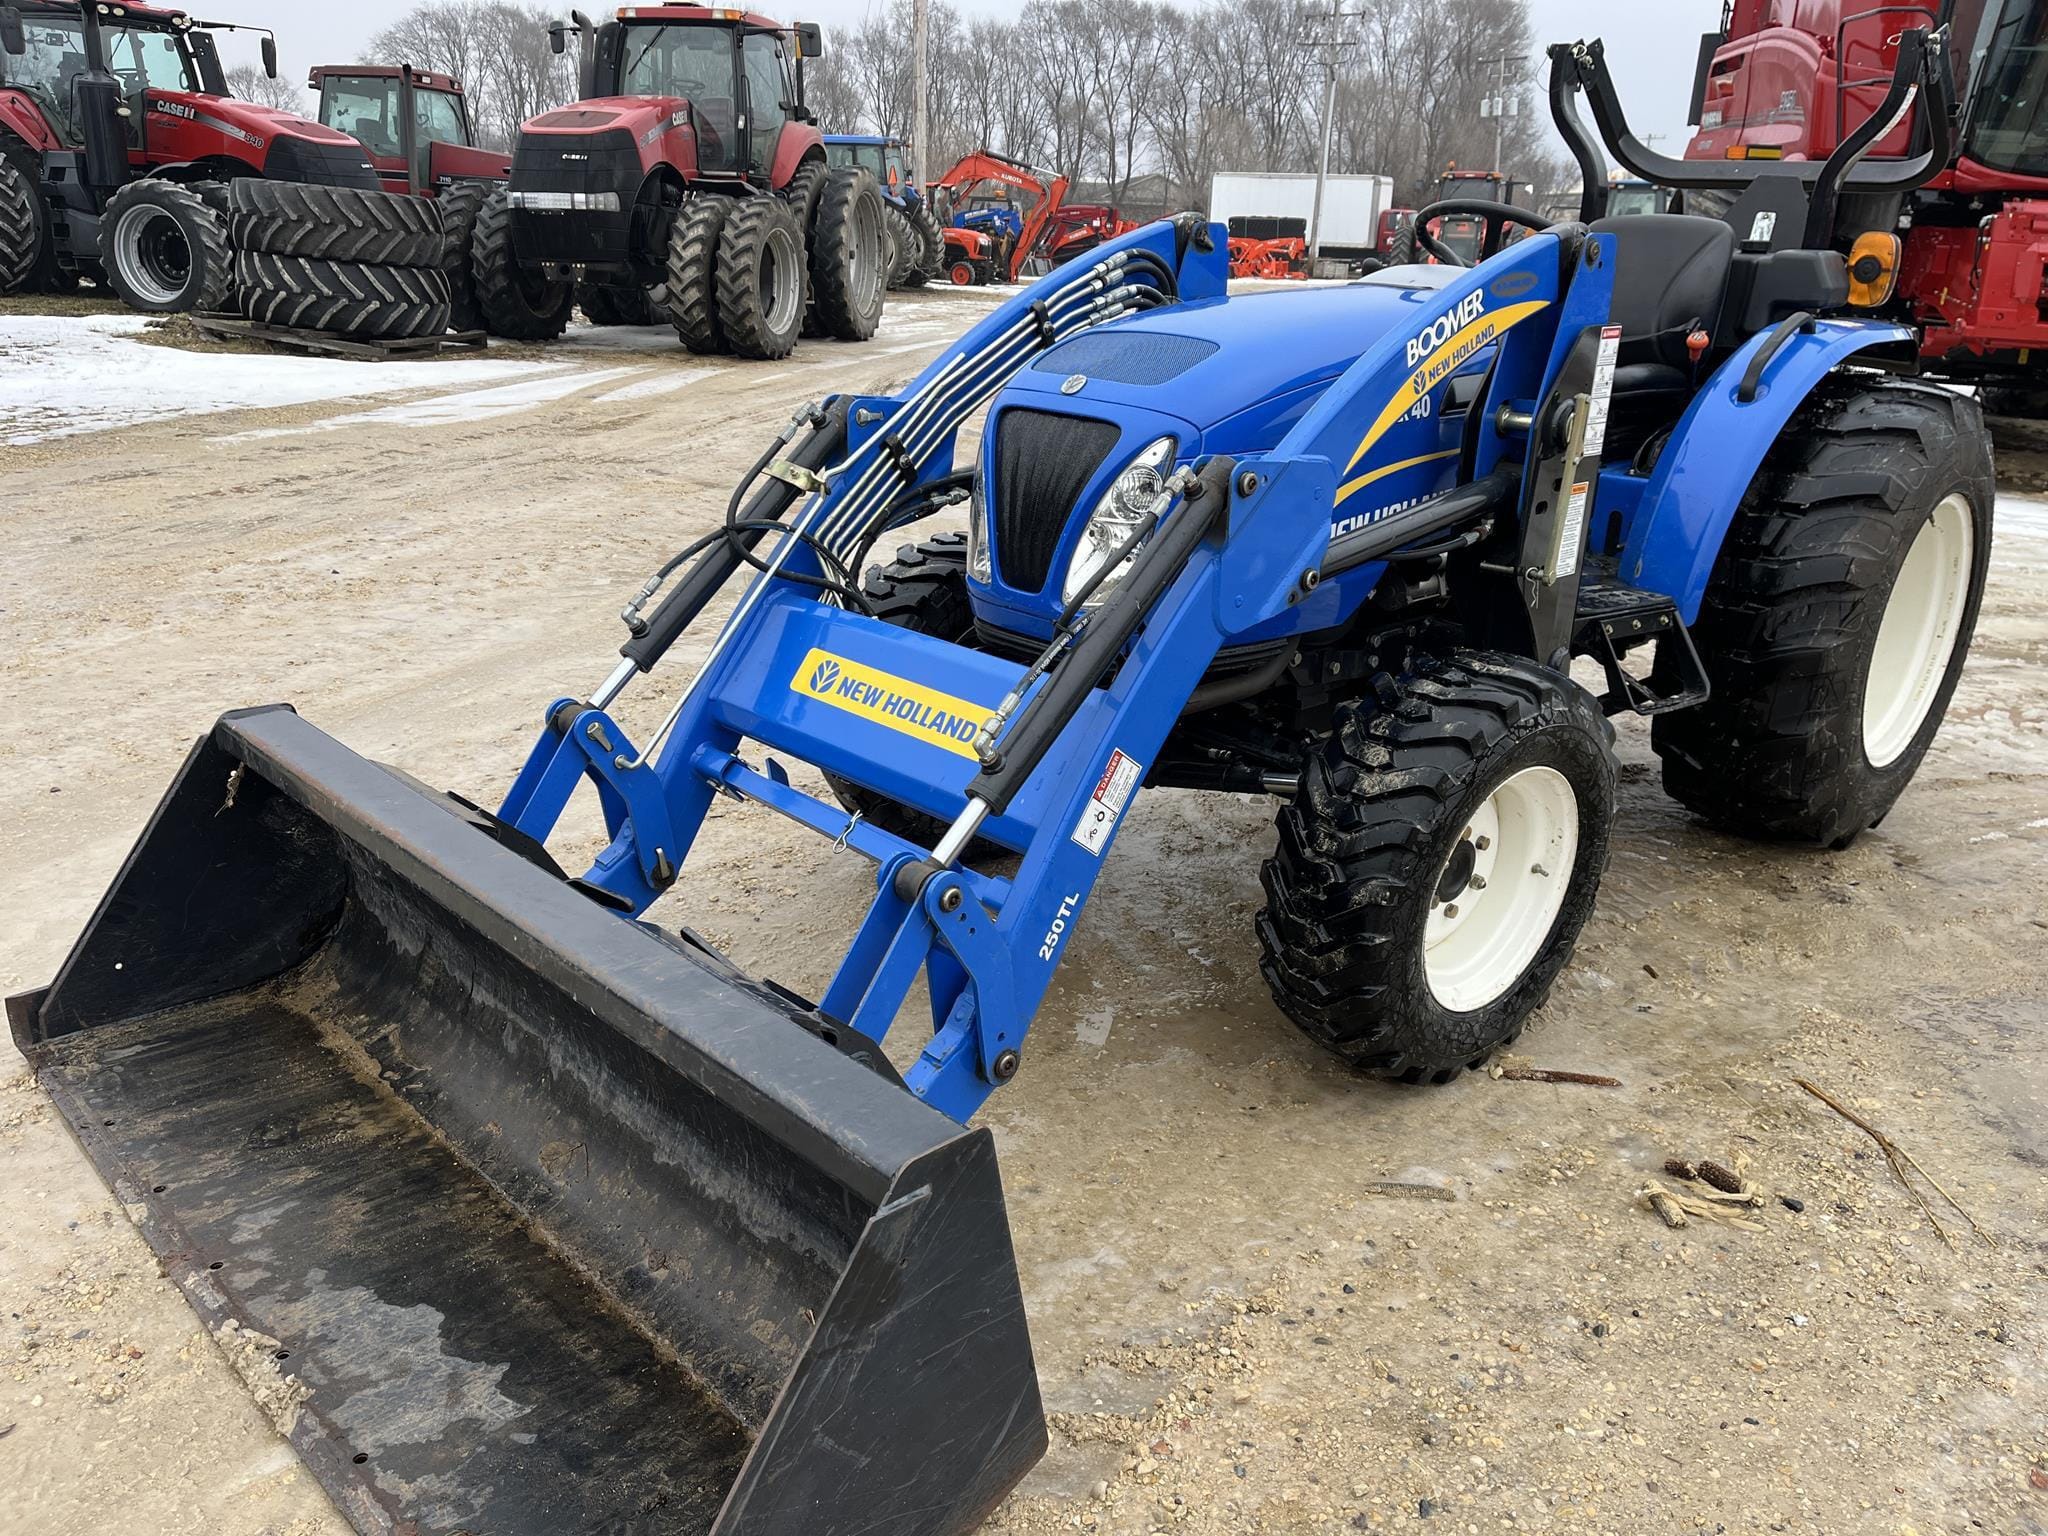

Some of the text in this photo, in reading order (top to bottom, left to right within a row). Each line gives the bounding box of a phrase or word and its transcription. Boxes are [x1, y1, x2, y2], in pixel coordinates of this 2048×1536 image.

[244, 133, 264, 149] 340
[1001, 173, 1023, 185] KUBOTA
[1407, 288, 1485, 368] BOOMER
[1428, 323, 1495, 383] NEW HOLLAND
[1411, 394, 1431, 420] 40
[836, 676, 977, 744] NEW HOLLAND
[1101, 755, 1120, 788] DANGER
[1039, 893, 1080, 961] 250TL
